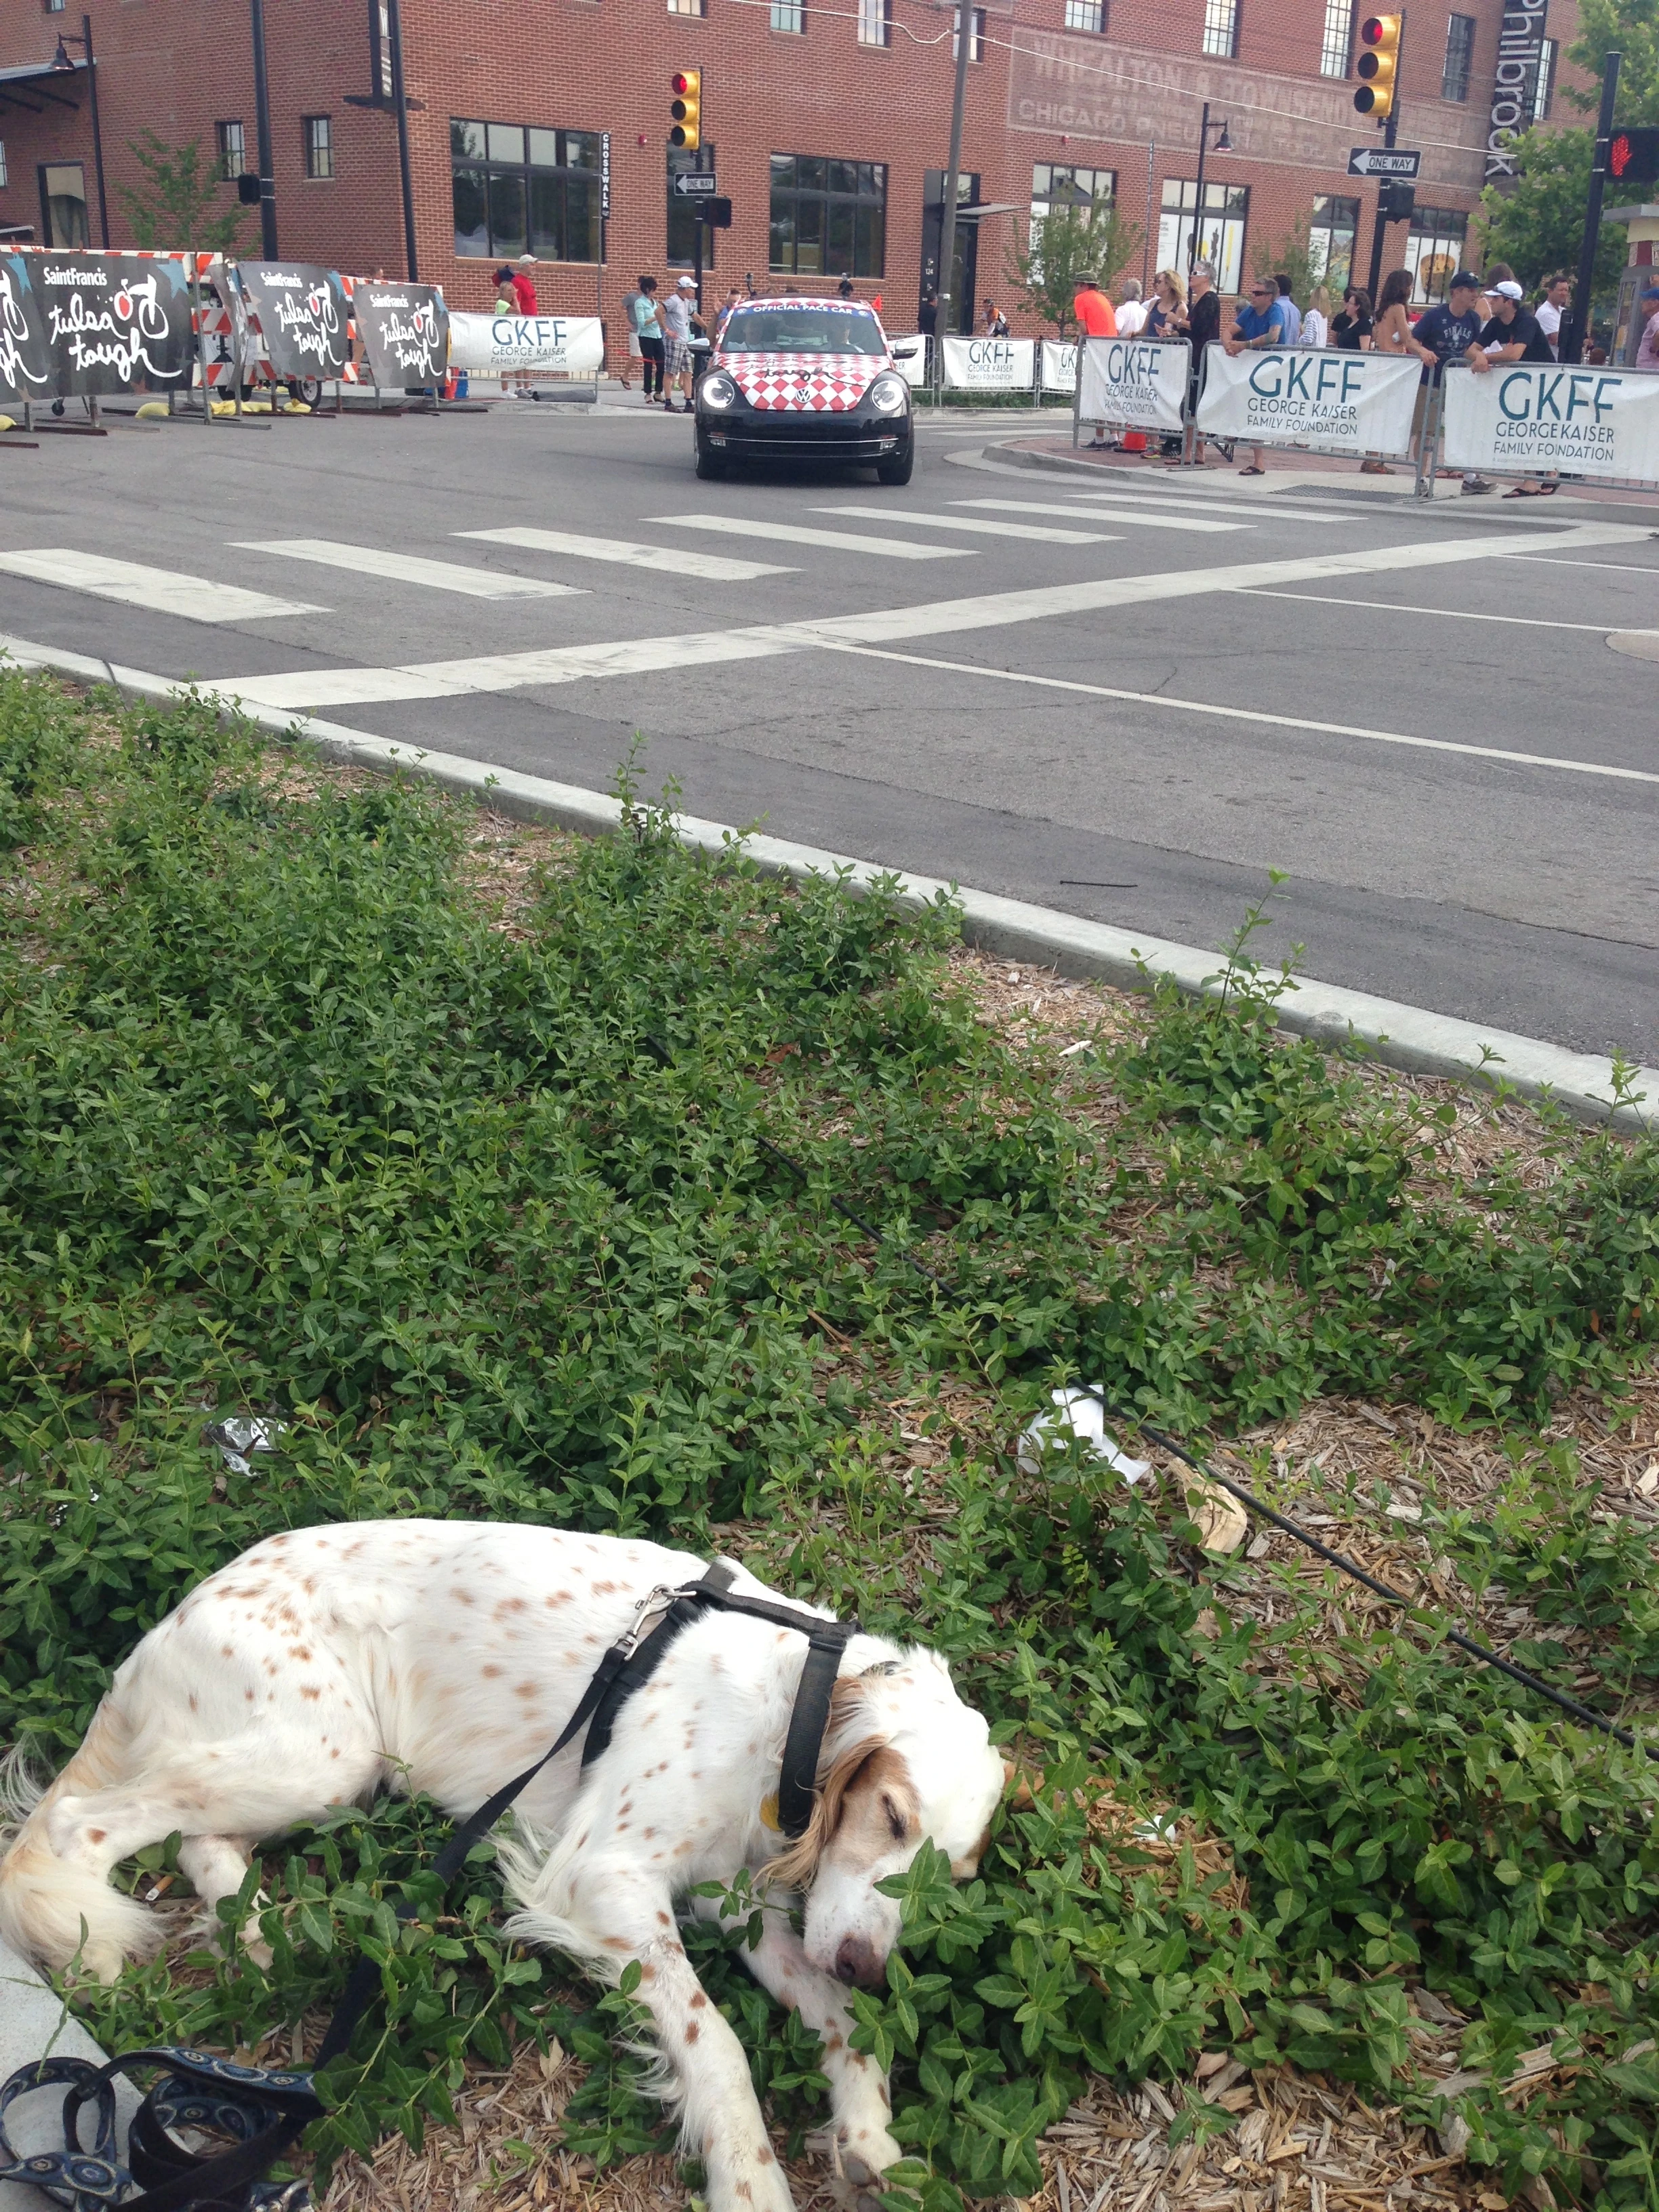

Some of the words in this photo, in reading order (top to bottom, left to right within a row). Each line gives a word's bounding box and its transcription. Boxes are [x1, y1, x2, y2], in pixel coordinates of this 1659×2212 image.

[1018, 98, 1126, 134] CHICAGO
[602, 134, 610, 208] CROSSWALK
[1369, 157, 1387, 169] ONE
[1391, 157, 1412, 170] WAY
[687, 178, 699, 188] ONE
[700, 179, 713, 188] WAY
[43, 265, 108, 286] SaintFrancis
[260, 271, 303, 288] SaintFrancis
[369, 293, 409, 308] SaintFrancis
[753, 304, 800, 313] OFFICIAL
[831, 306, 853, 314] CAR
[48, 292, 129, 345] tulsa
[274, 291, 320, 333] tulsa
[380, 312, 423, 350] tulsa
[492, 319, 567, 346] GKFF
[1443, 325, 1472, 340] FINALS
[68, 327, 183, 382] tough
[293, 323, 343, 367] tough
[492, 346, 532, 356] GEORGE
[537, 348, 566, 356] KAISER
[969, 341, 1015, 364] GKFF
[395, 338, 443, 378] tough
[491, 356, 518, 365] FAMILY
[968, 364, 990, 372] GEORGE
[1108, 344, 1161, 386] GKFF
[1248, 355, 1366, 403] GKFF
[1105, 383, 1133, 399] GEORGE
[1499, 371, 1622, 424] GKFF
[1248, 398, 1306, 416] GEORGE
[1311, 403, 1357, 420] KAISER
[1247, 415, 1283, 429] FAMILY
[1285, 419, 1357, 434] FOUNDATION
[1496, 422, 1558, 438] GEORGE
[1560, 424, 1614, 444] KAISER
[1494, 441, 1534, 455] FAMILY
[1537, 443, 1614, 462] FOUNDATION
